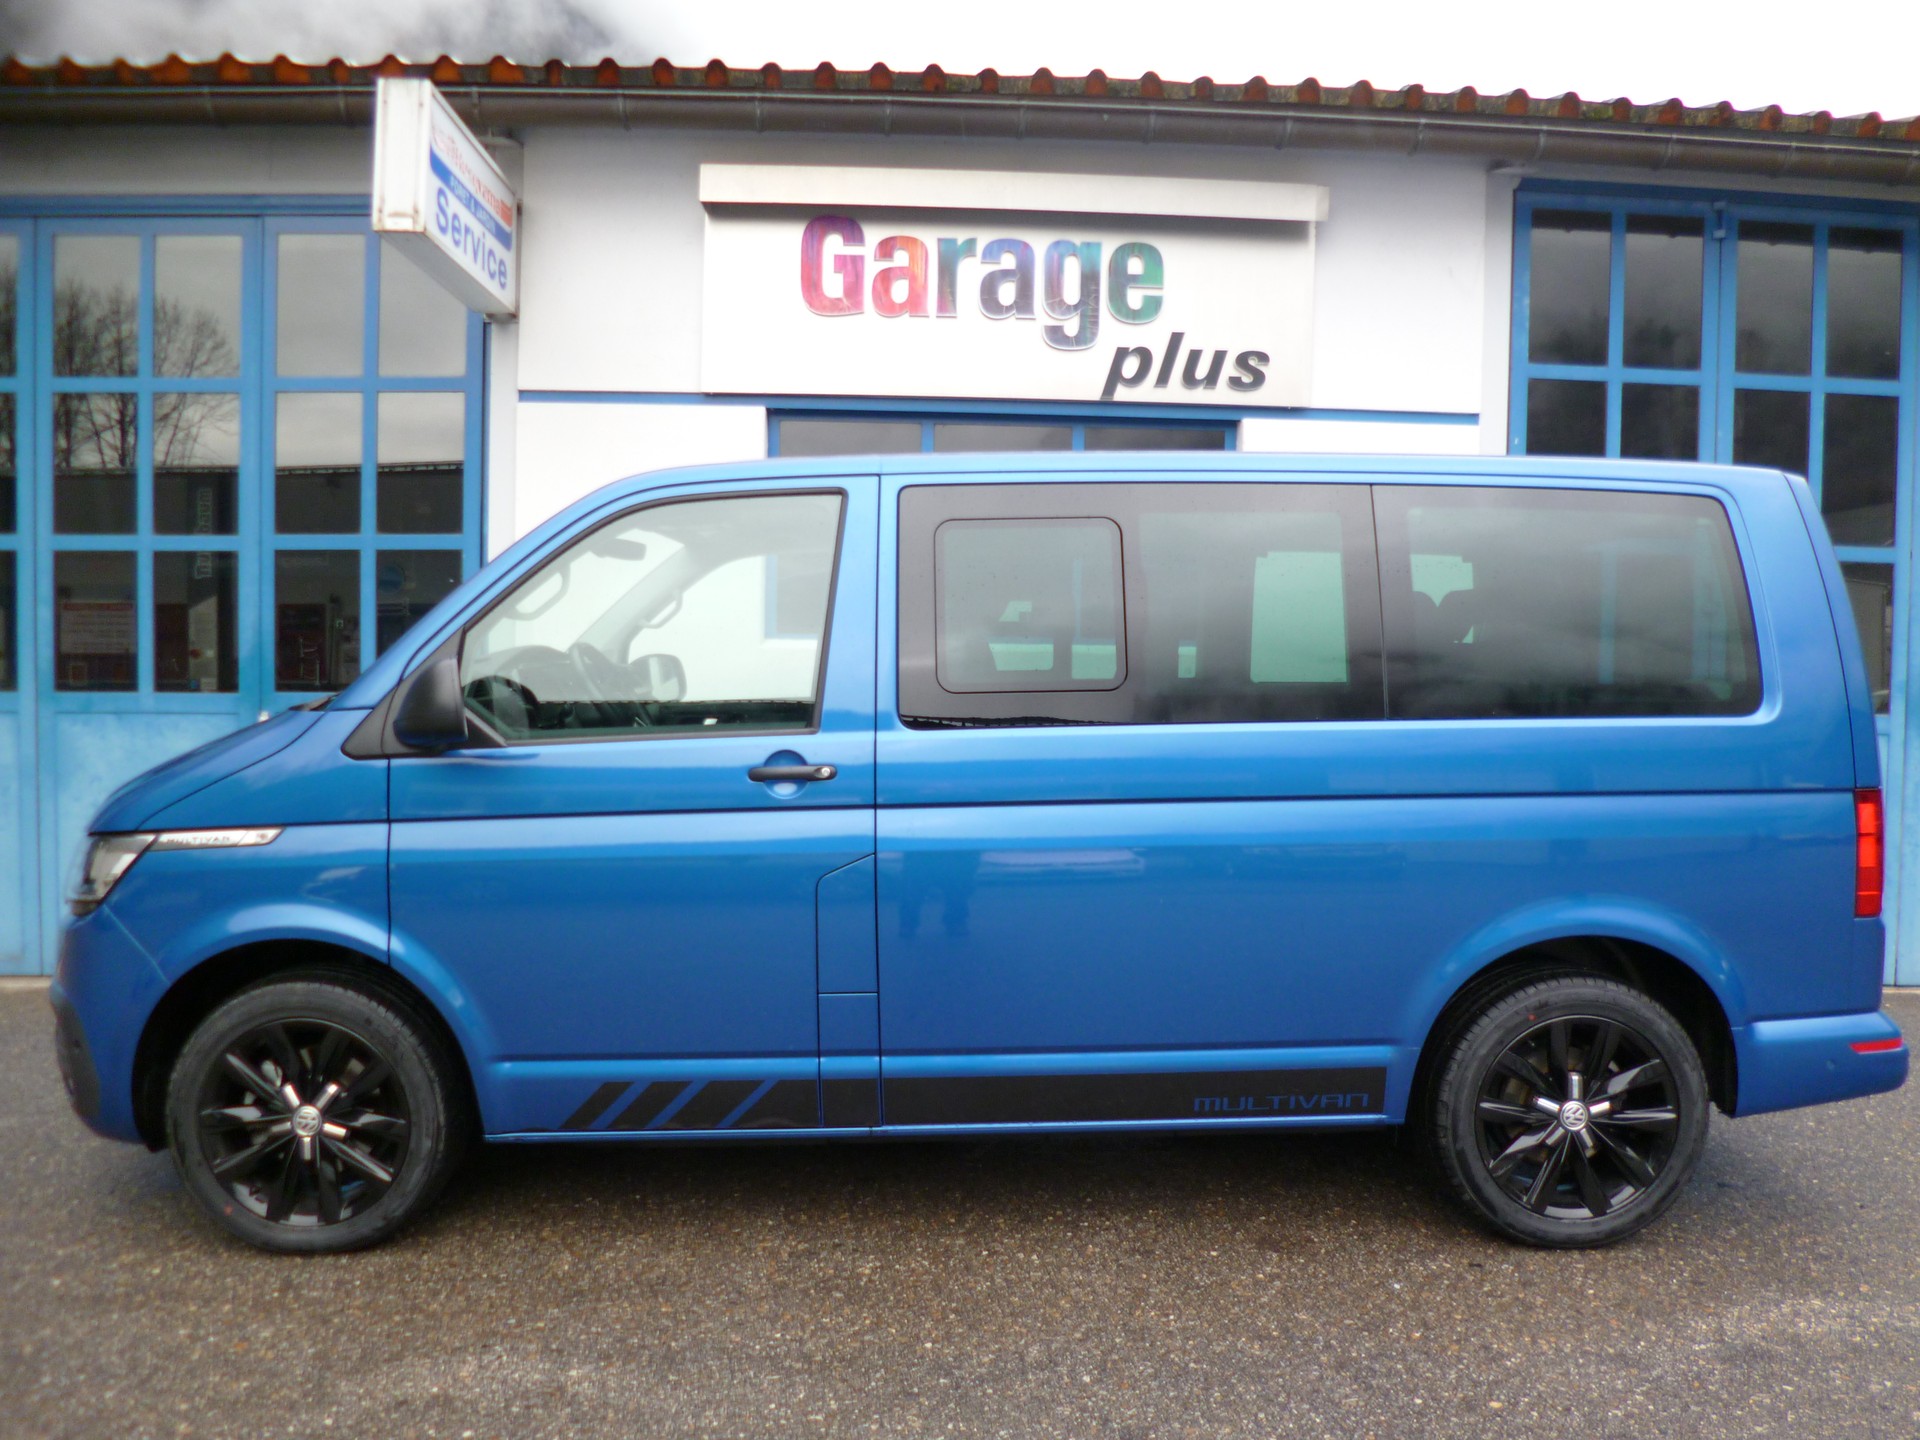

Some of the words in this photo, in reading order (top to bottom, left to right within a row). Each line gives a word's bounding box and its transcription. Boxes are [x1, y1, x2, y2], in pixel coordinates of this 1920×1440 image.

[436, 187, 507, 290] Service
[801, 215, 1163, 350] Garage
[1100, 332, 1270, 400] plus
[1193, 1093, 1368, 1112] MULTIVAN
